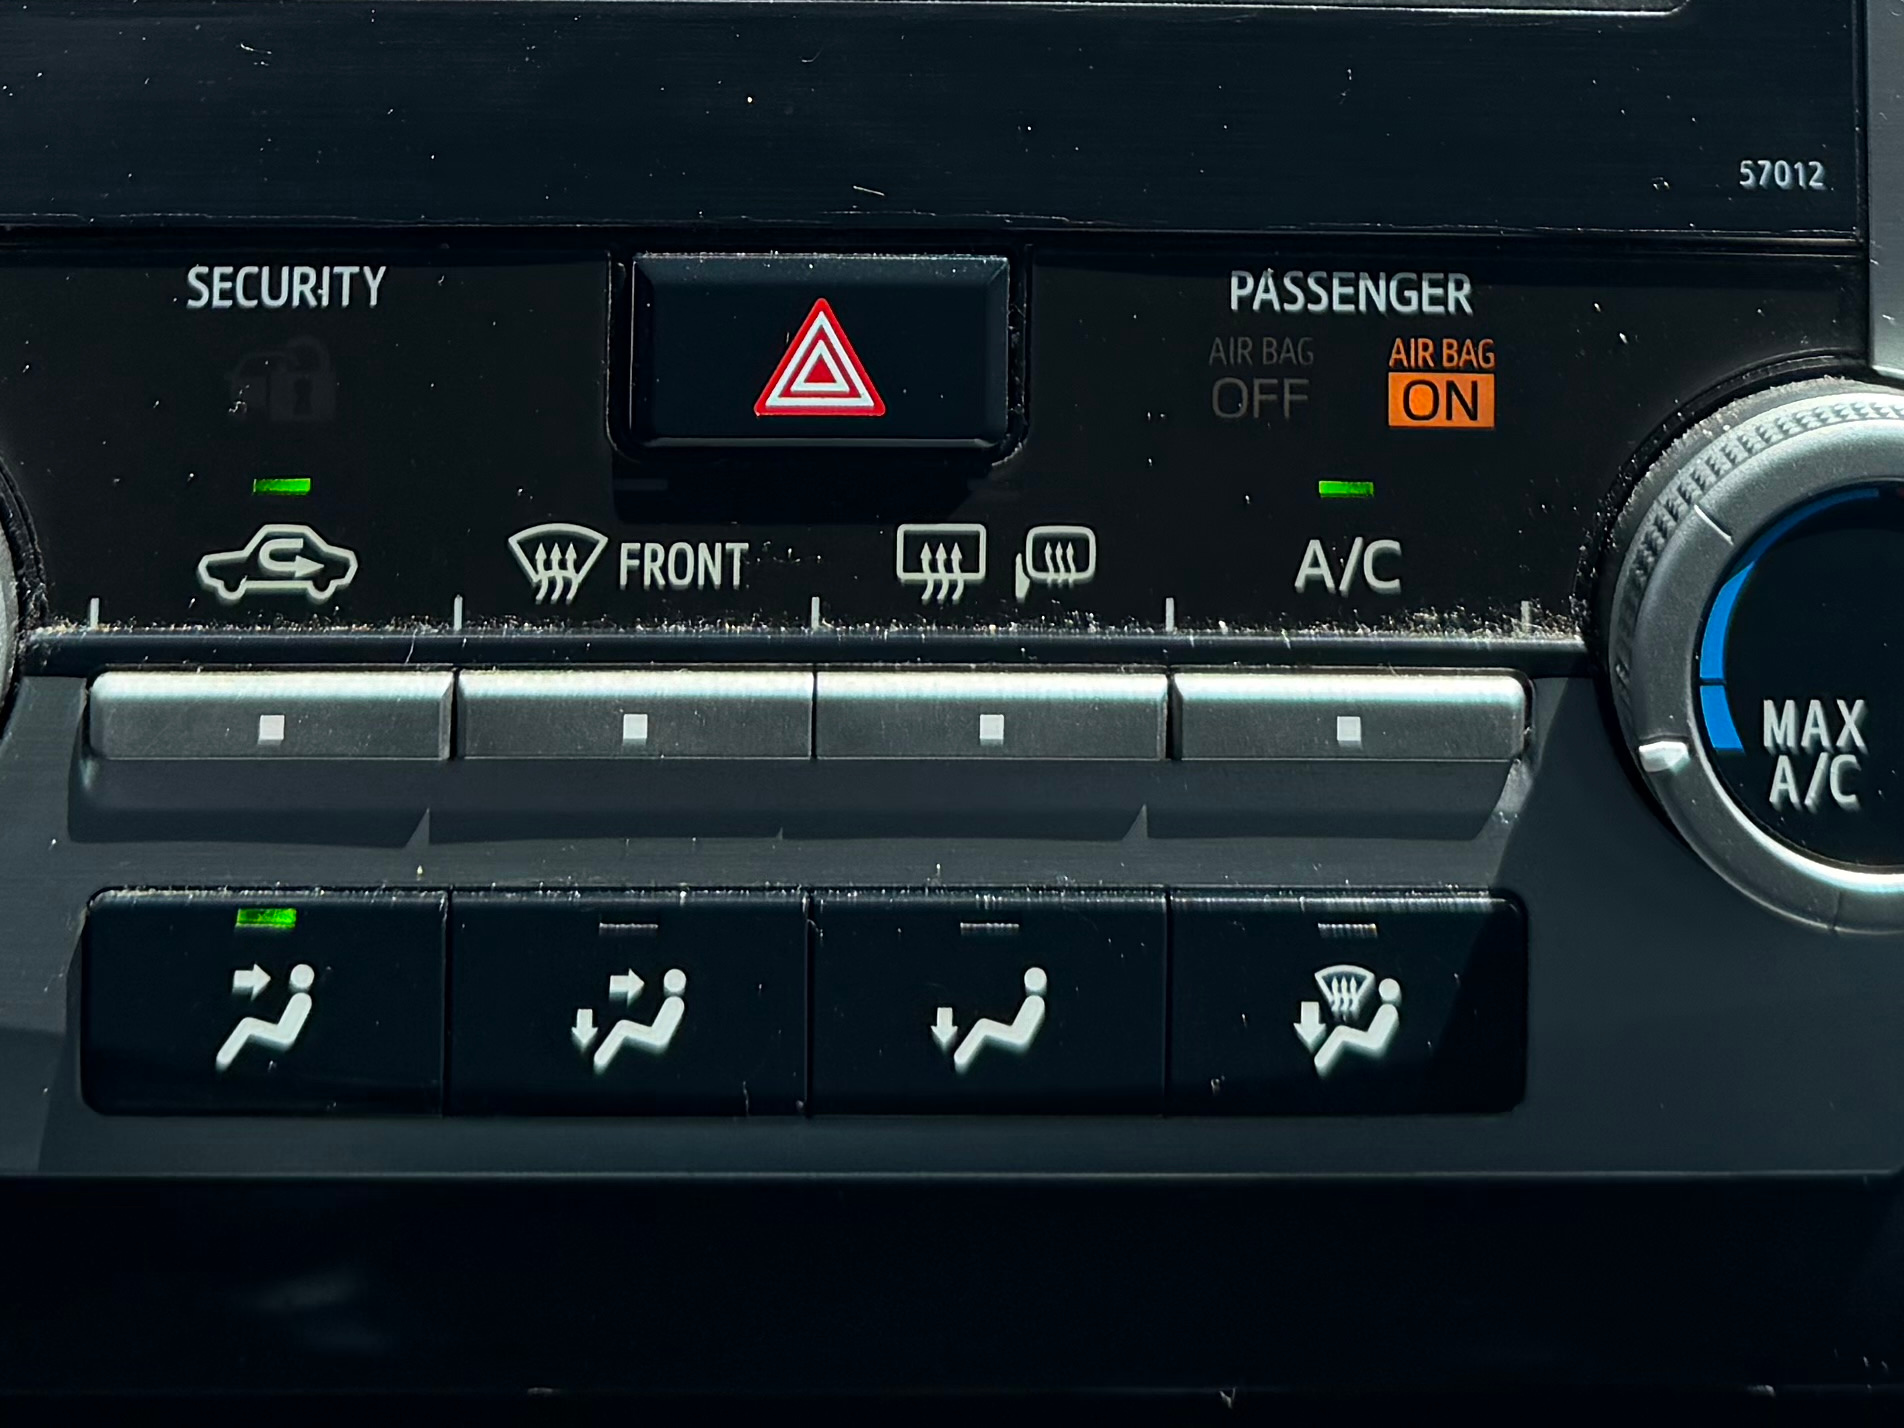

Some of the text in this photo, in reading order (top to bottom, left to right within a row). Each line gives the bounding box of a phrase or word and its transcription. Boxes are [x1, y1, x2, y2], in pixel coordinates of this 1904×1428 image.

[1739, 159, 1827, 191] 57012
[186, 264, 387, 310] SECURITY
[1229, 269, 1474, 316] PASSENGER
[1208, 337, 1315, 366] AIR BAG
[1388, 337, 1496, 370] AIR BAG
[1211, 376, 1310, 420] OFF
[1402, 378, 1479, 421] ON
[619, 541, 749, 590] FRONT
[1294, 536, 1403, 598] A/C
[1763, 699, 1869, 755] MAX
[1768, 751, 1862, 815] A/C
